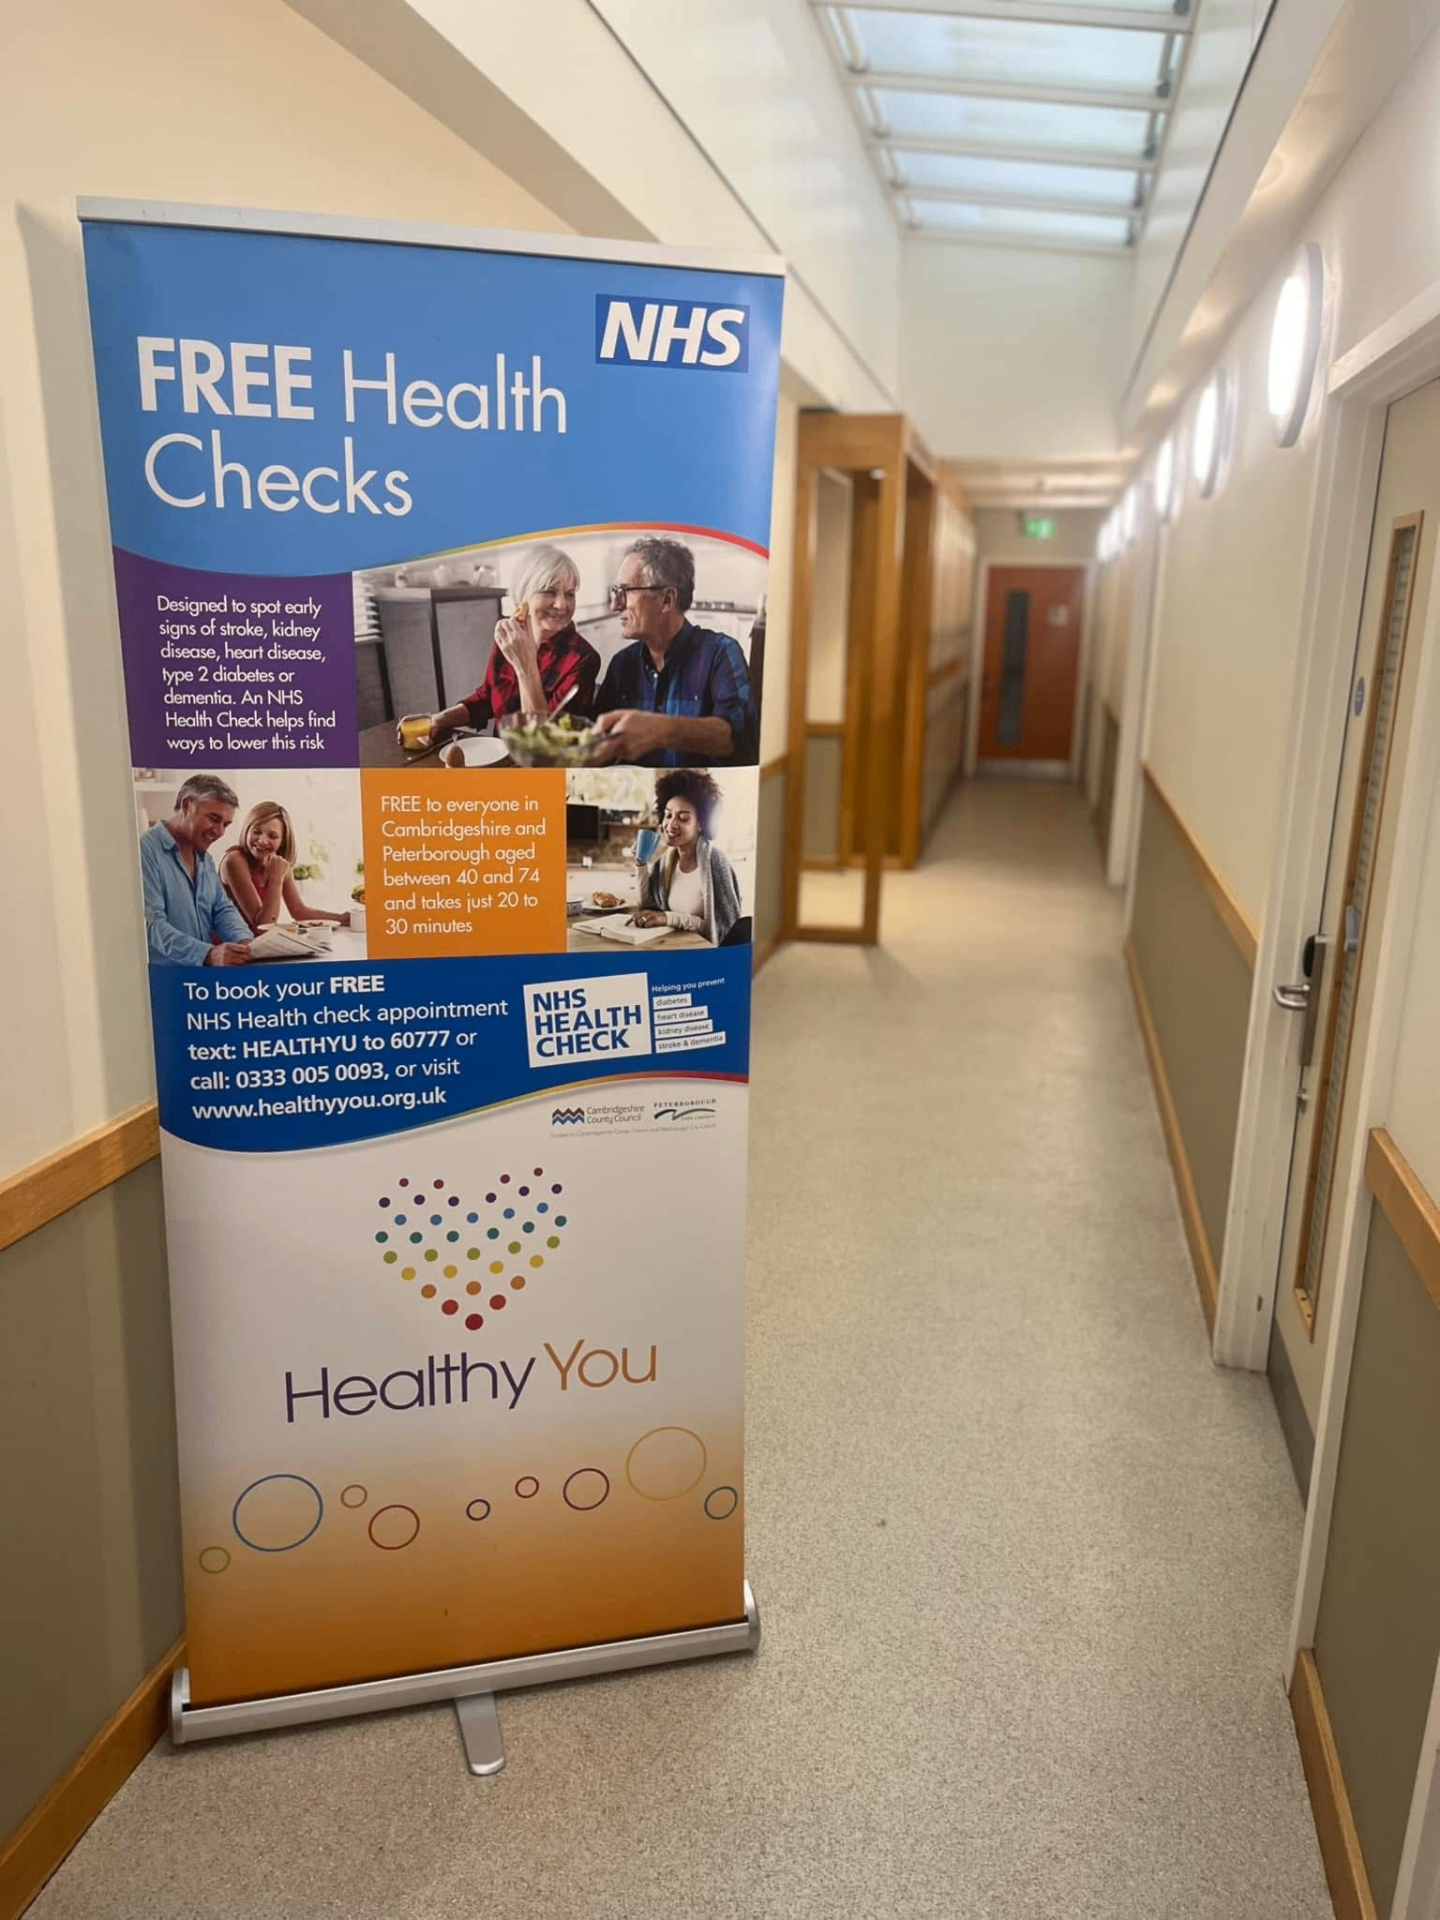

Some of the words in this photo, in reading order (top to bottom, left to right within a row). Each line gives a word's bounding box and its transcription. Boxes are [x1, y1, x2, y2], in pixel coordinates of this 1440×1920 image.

[600, 301, 746, 367] NHS
[137, 336, 315, 421] FREE
[343, 349, 567, 434] Health
[144, 429, 413, 517] Checks
[157, 594, 227, 617] Designed
[231, 598, 246, 613] to
[250, 600, 281, 618] spot
[284, 596, 322, 620] early
[159, 619, 196, 640] signs
[200, 618, 216, 636] of
[220, 618, 268, 639] stroke,
[272, 619, 321, 642] kidney
[160, 640, 221, 662] disease,
[225, 641, 264, 660] heart
[267, 642, 326, 663] disease,
[162, 667, 194, 686] type
[198, 666, 209, 682] 2
[212, 664, 275, 682] diabetes
[278, 671, 295, 682] or
[164, 686, 236, 705] dementia.
[240, 690, 263, 705] An
[268, 690, 303, 705] NHS
[165, 710, 212, 727] Health
[216, 710, 263, 727] Check
[267, 710, 304, 732] helps
[308, 710, 336, 727] find
[166, 738, 205, 754] ways
[209, 736, 223, 749] to
[227, 732, 268, 749] lower
[272, 732, 296, 749] this
[300, 732, 325, 749] risk
[380, 795, 421, 812] FREE
[426, 797, 442, 812] to
[446, 799, 520, 816] everyone
[525, 795, 539, 811] in
[381, 818, 511, 841] Cambridgeshire
[515, 817, 546, 836] and
[383, 842, 490, 865] Peterborough
[495, 841, 536, 864] aged
[383, 868, 450, 886] between
[455, 869, 478, 885] 40
[483, 866, 514, 884] and
[519, 867, 540, 884] 74
[384, 892, 416, 911] and
[421, 892, 462, 910] takes
[467, 892, 493, 914] just
[497, 891, 519, 908] 20
[523, 893, 538, 907] to
[385, 918, 408, 934] 30
[413, 918, 473, 933] minutes
[183, 982, 209, 1001] To
[215, 979, 271, 1000] book
[275, 979, 325, 1002] your
[330, 974, 385, 995] FREE
[651, 983, 682, 994] Helping
[682, 982, 697, 991] you
[697, 977, 725, 988] prevent
[532, 988, 586, 1013] NHS
[656, 996, 688, 1006] diabetes
[187, 1012, 232, 1031] NHS
[238, 1007, 307, 1029] Health
[313, 1004, 372, 1025] check
[377, 999, 508, 1025] appointment
[534, 1004, 642, 1036] HEALTH
[657, 1012, 677, 1020] heart
[678, 1010, 705, 1019] disease
[658, 1026, 682, 1035] kidney
[683, 1023, 709, 1032] disease
[187, 1043, 237, 1061] text:
[243, 1034, 357, 1059] HEALTHYU
[362, 1034, 385, 1051] to
[390, 1030, 451, 1050] 60777
[455, 1031, 477, 1046] or
[536, 1028, 630, 1058] CHECK
[658, 1041, 681, 1049] stroke
[689, 1035, 723, 1046] dementia
[190, 1071, 230, 1090] call:
[235, 1069, 286, 1088] 0333
[291, 1065, 330, 1085] 005
[334, 1062, 390, 1084] 0093,
[394, 1064, 417, 1078] or
[421, 1057, 460, 1076] visit
[191, 1086, 447, 1120] www.healthyyou.org.uk
[586, 1104, 645, 1115] Cambridgeshire
[653, 1098, 716, 1108] PETERBOROUGH
[586, 1114, 614, 1125] County
[614, 1112, 642, 1123] Council
[285, 1351, 536, 1423] Healthy
[543, 1338, 657, 1392] You
